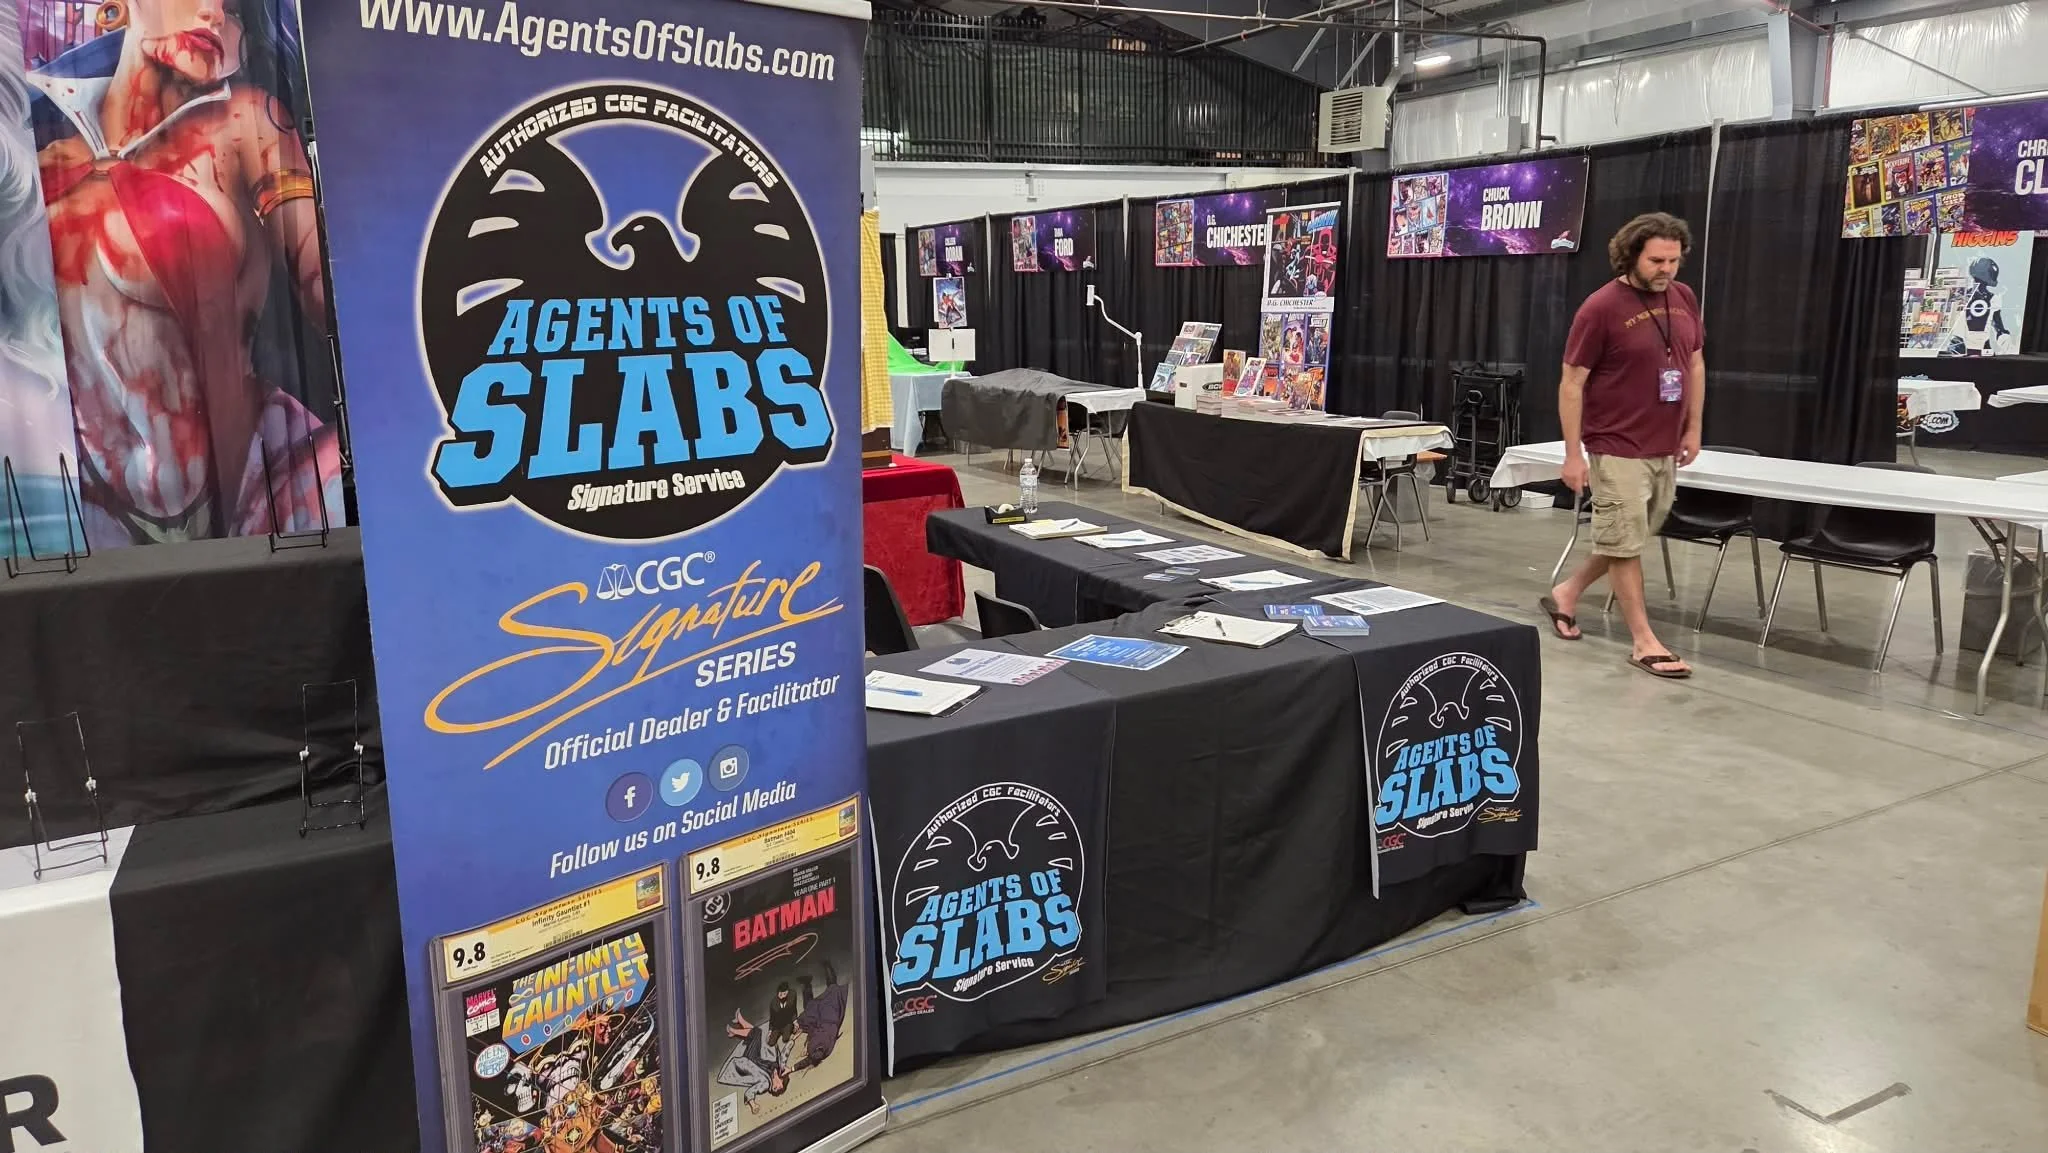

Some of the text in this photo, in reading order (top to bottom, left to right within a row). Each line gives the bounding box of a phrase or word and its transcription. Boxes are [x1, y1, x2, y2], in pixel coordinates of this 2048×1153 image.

[479, 94, 779, 188] AUTHORIZED CGC FACILITATORS
[2018, 139, 2048, 158] CHR
[1483, 187, 1511, 202] CHUCK
[2015, 159, 2048, 195] CL
[1481, 200, 1543, 231] BROWN
[1951, 230, 2018, 248] HIGGINS
[1055, 237, 1073, 256] FORD
[486, 295, 788, 356] AGENTS OF
[434, 347, 834, 488] SLABS
[567, 468, 746, 513] Signature Service
[424, 560, 844, 769] Signature
[695, 640, 797, 688] SERIES
[1399, 660, 1439, 699] Authorized
[1442, 655, 1457, 666] CGC
[544, 672, 840, 771] Official Dealer & Facilitator
[1392, 724, 1497, 773] AGENTS OF
[1375, 747, 1518, 826] SLABS
[550, 780, 797, 879] Follow us on Social Media
[926, 786, 1061, 839] Authorized CGC Facilitators
[696, 857, 721, 880] 9.8
[555, 903, 582, 917] Gauntlet
[734, 886, 836, 950] BATMAN
[916, 868, 1062, 923] AGENTS OF
[452, 942, 486, 968] 9.8
[513, 972, 535, 992] THE
[534, 932, 646, 995] INFINITY
[892, 893, 1081, 986] SLABS
[466, 988, 497, 1006] MARVEL
[502, 953, 650, 1039] GAUNTLET
[953, 965, 993, 994] Signature
[995, 957, 1035, 975] Service
